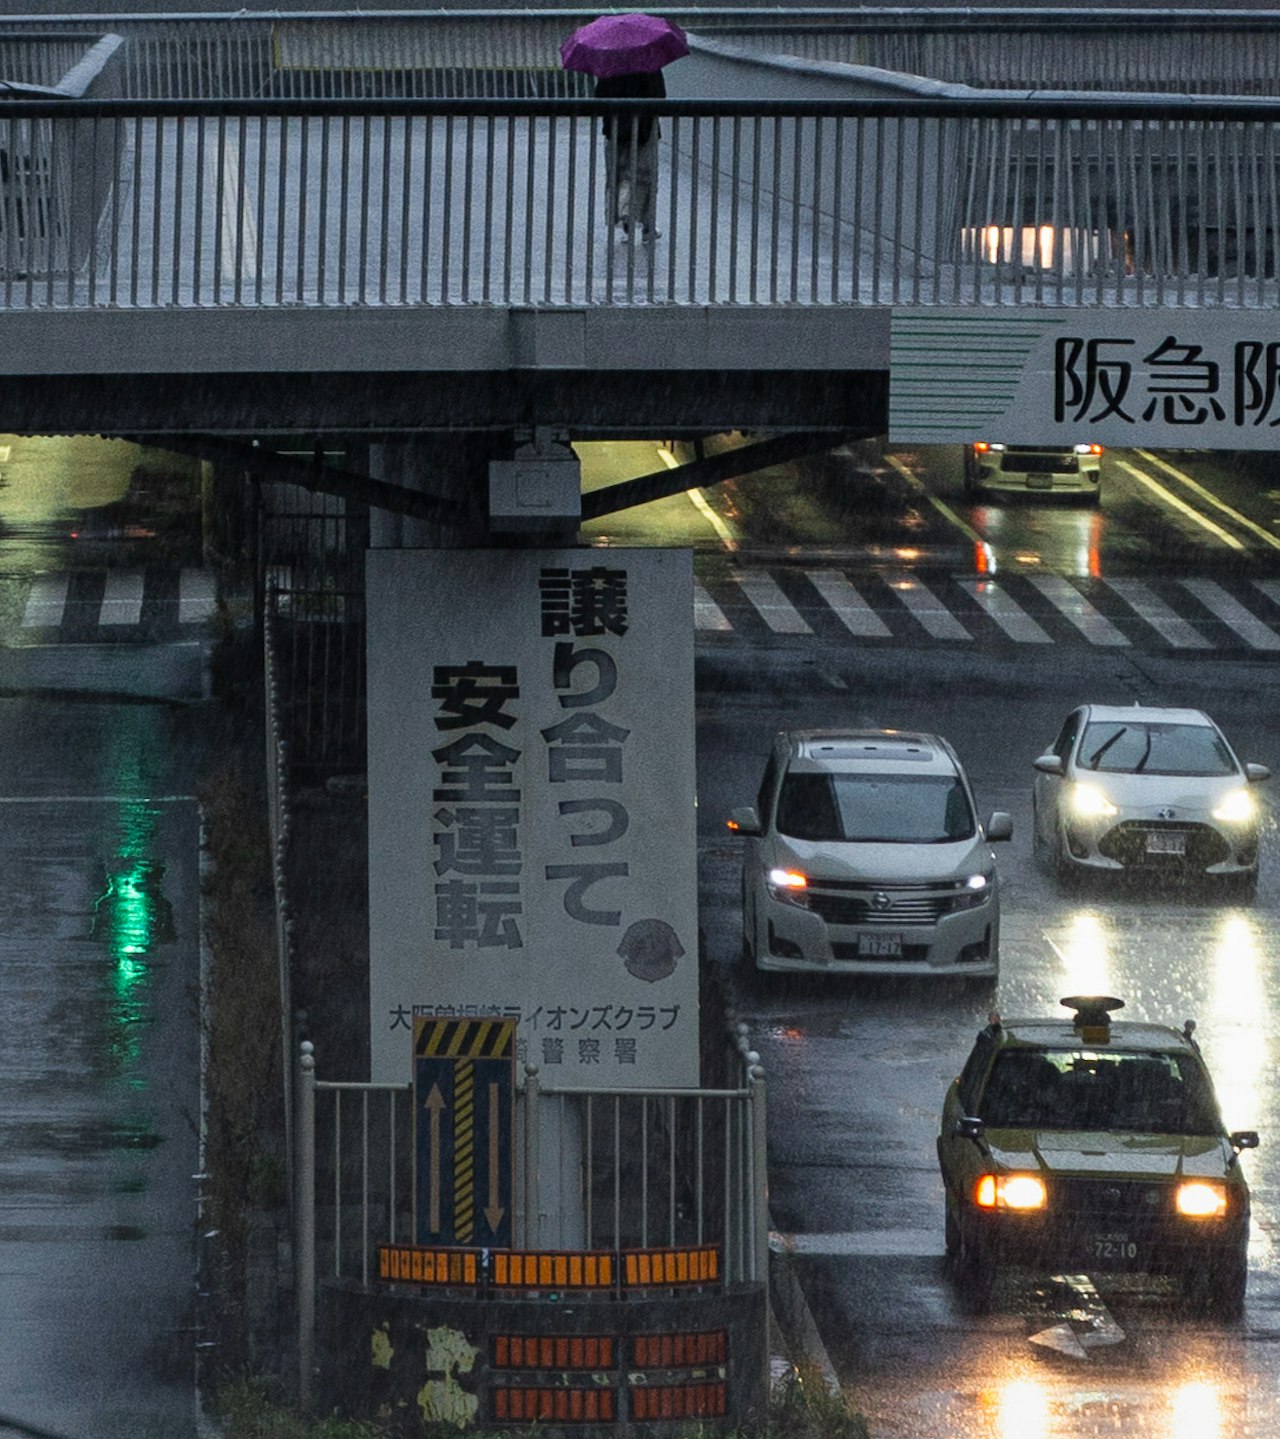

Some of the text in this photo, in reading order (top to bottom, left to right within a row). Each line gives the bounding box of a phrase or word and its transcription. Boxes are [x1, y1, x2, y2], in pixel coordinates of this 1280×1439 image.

[431, 660, 524, 950] 安全運転
[538, 565, 631, 927] 譲り合って
[1095, 1241, 1137, 1258] 72-10
